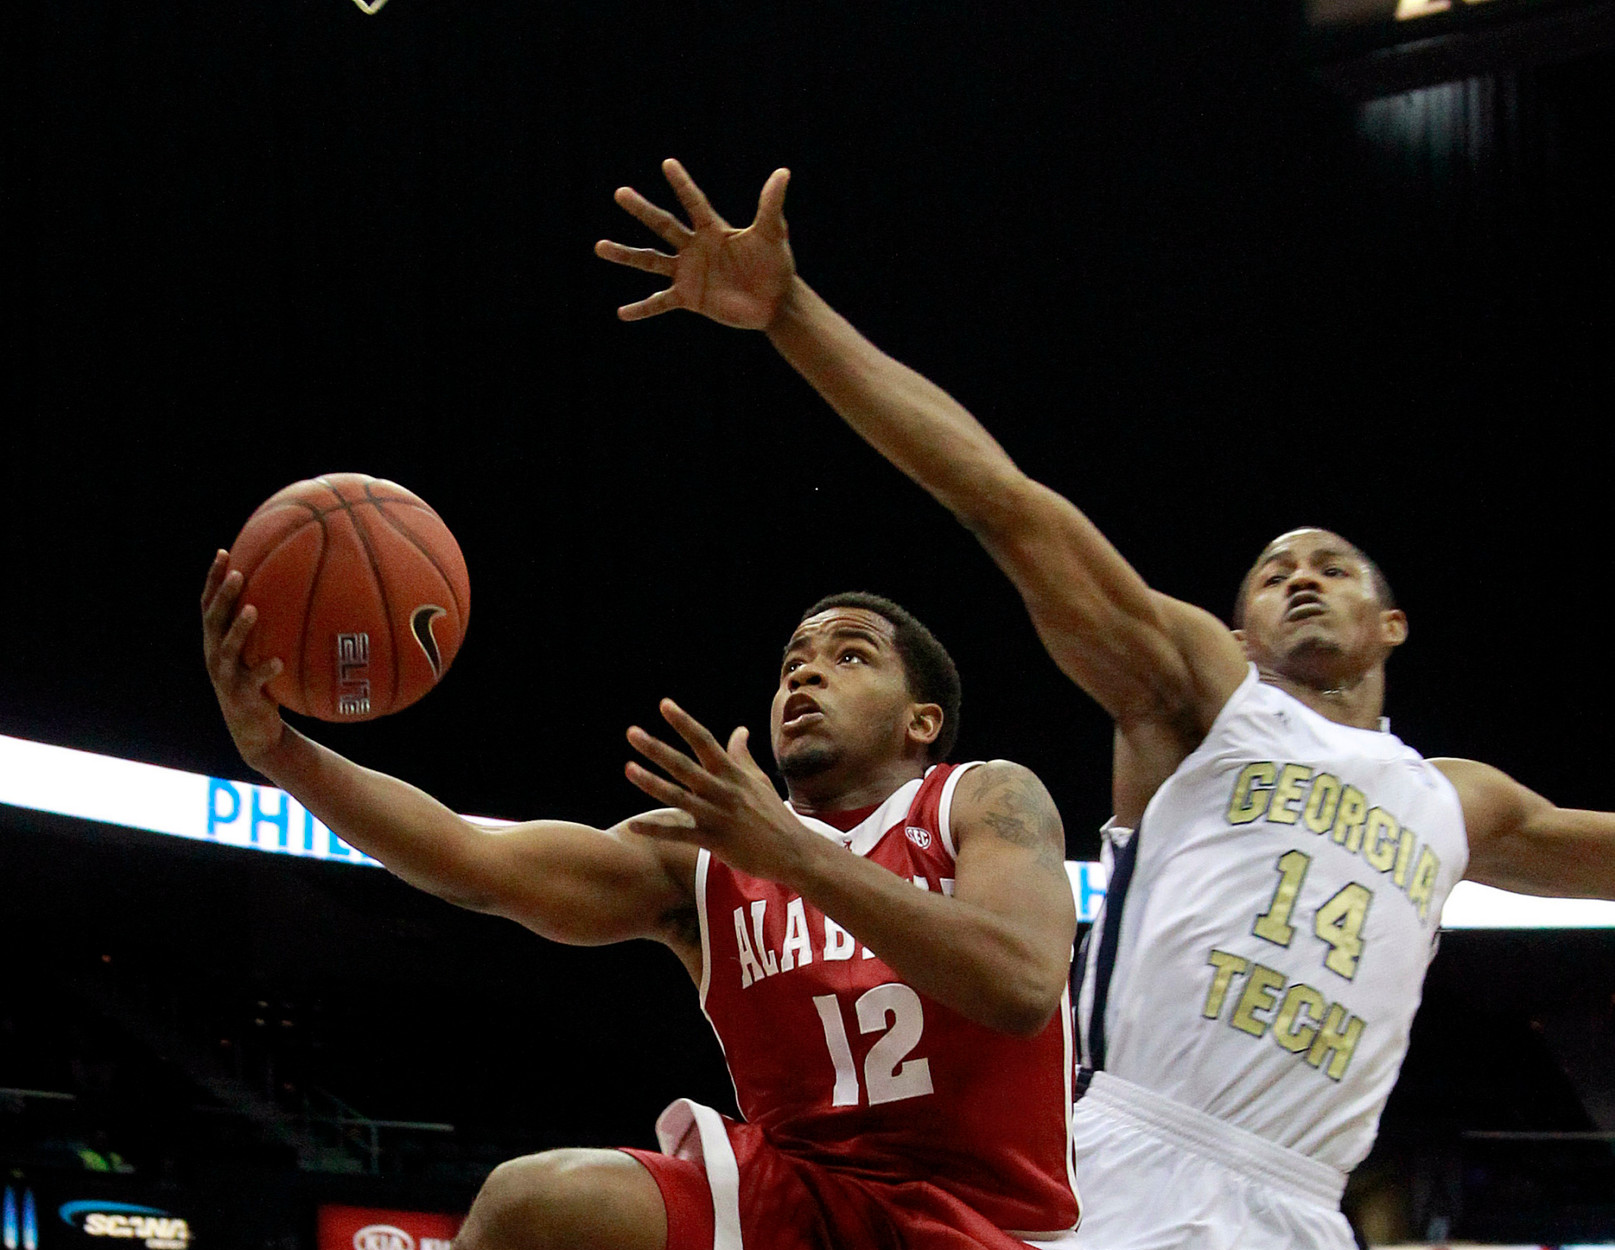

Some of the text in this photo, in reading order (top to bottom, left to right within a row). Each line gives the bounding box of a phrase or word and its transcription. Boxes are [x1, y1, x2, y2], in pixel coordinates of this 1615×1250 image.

[1227, 761, 1441, 924] GEORGIA
[1253, 850, 1373, 981] 14
[812, 983, 934, 1107] 12
[1203, 949, 1367, 1081] TECH
